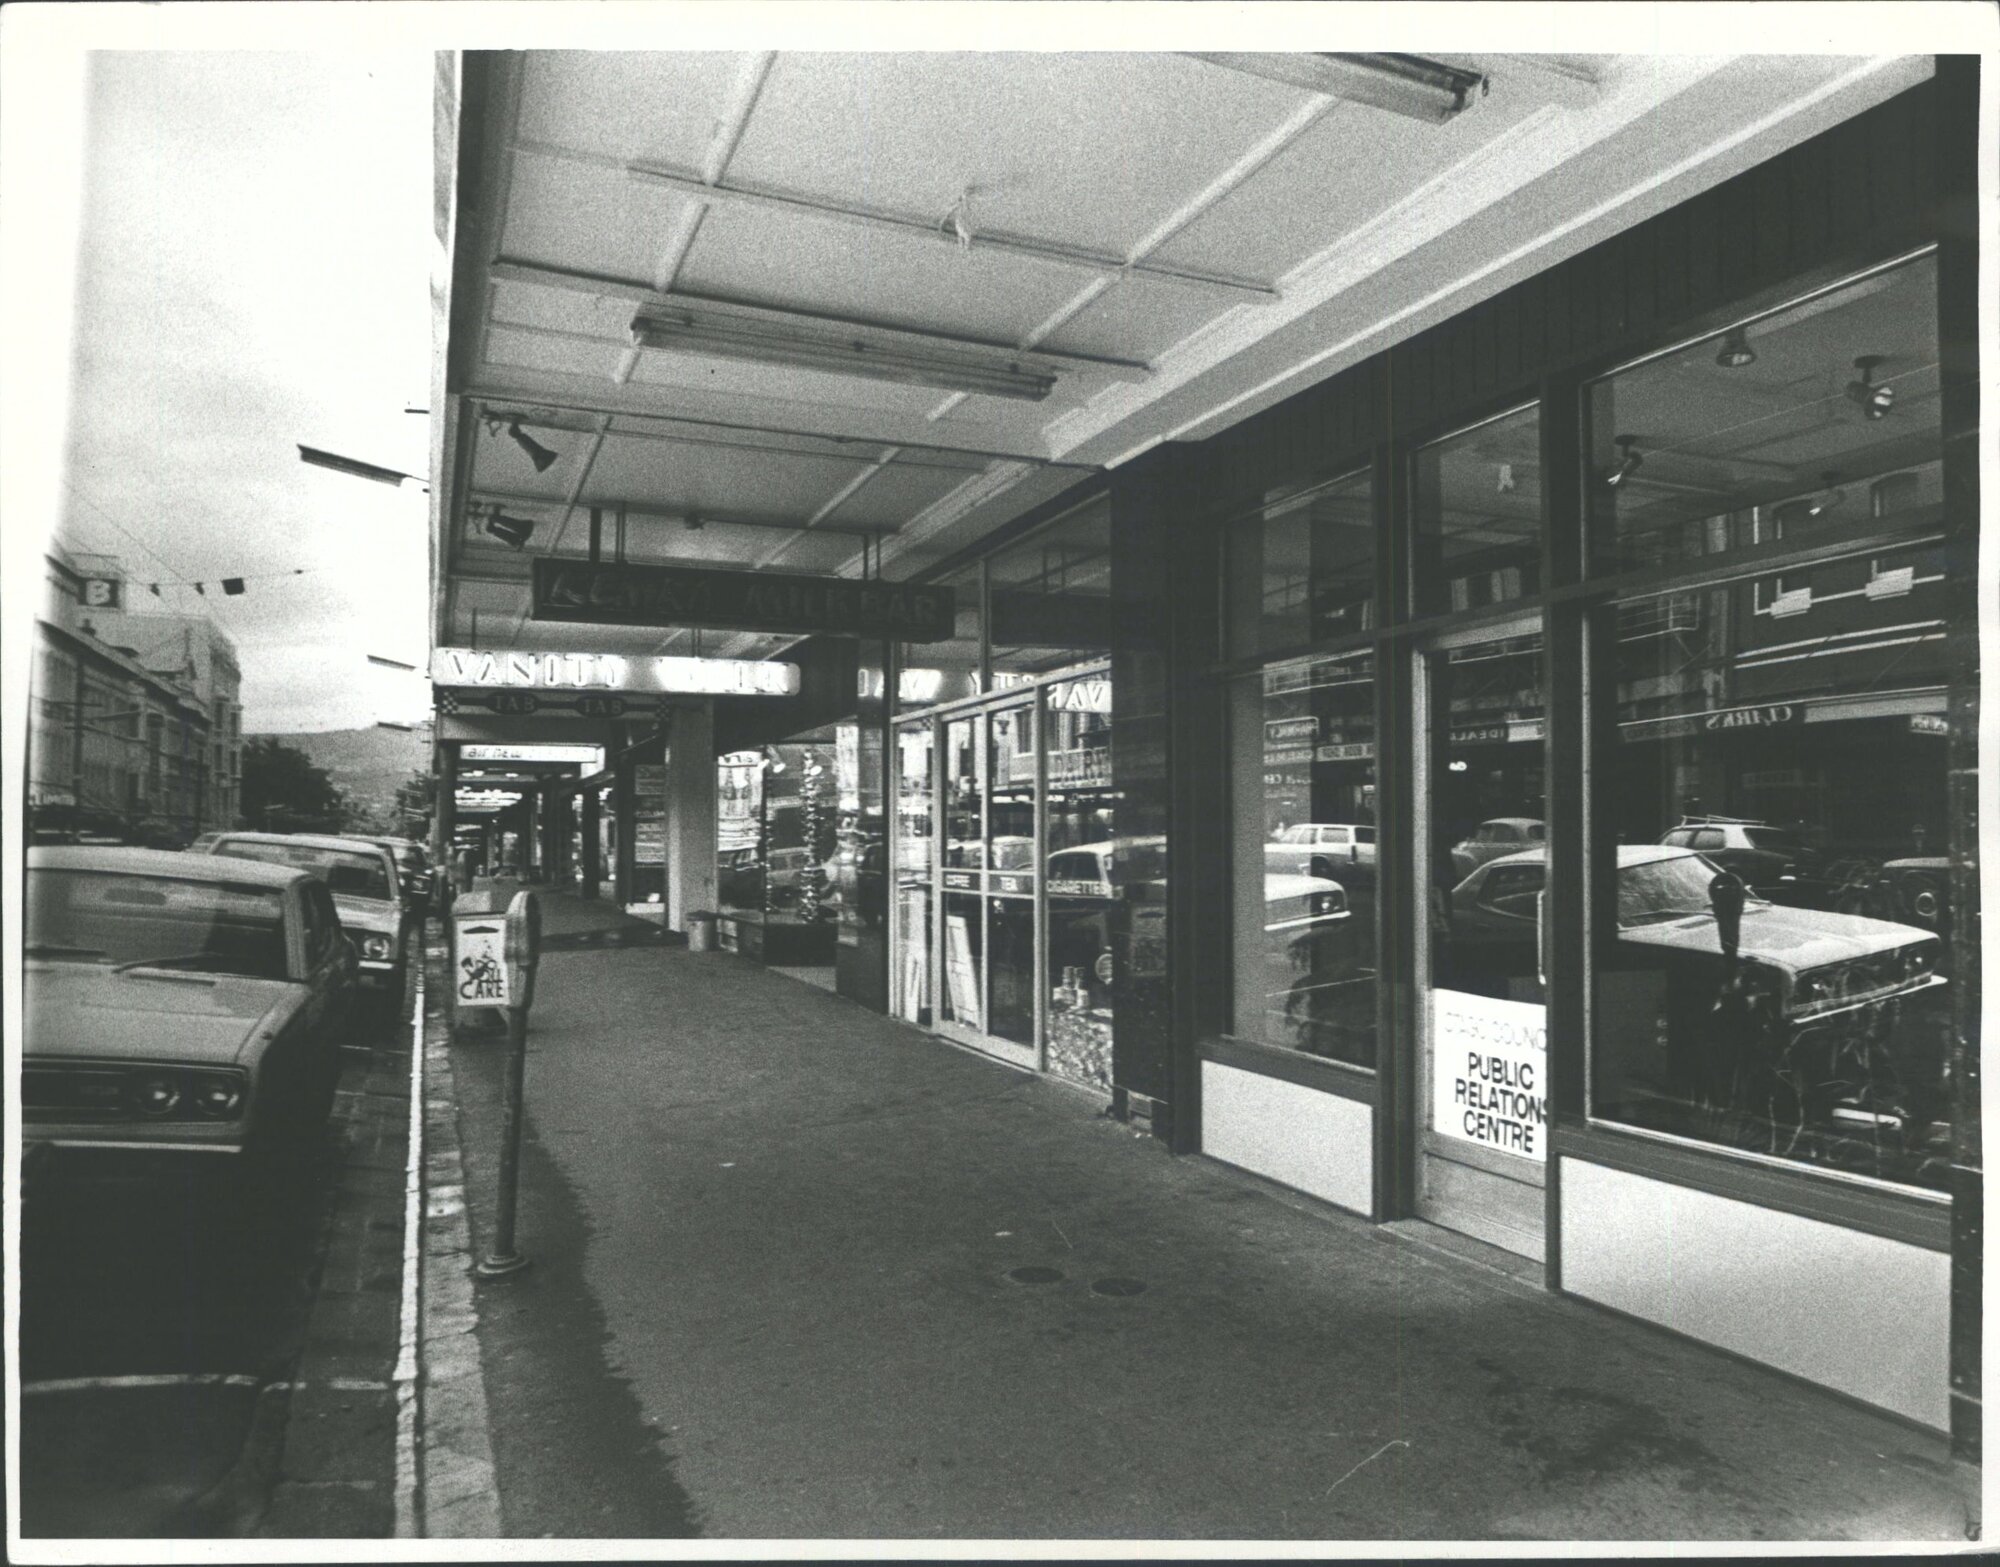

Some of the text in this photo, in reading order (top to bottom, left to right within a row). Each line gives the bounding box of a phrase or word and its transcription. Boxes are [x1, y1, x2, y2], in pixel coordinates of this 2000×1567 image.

[859, 589, 938, 625] BAR
[446, 651, 629, 688] VANITY
[495, 694, 536, 711] TAB
[584, 698, 623, 714] TAB
[1047, 879, 1110, 895] CIGARETTES
[460, 980, 504, 1000] CARE
[1468, 1051, 1534, 1090] PUBLIC
[1464, 1110, 1534, 1154] CENTRE
